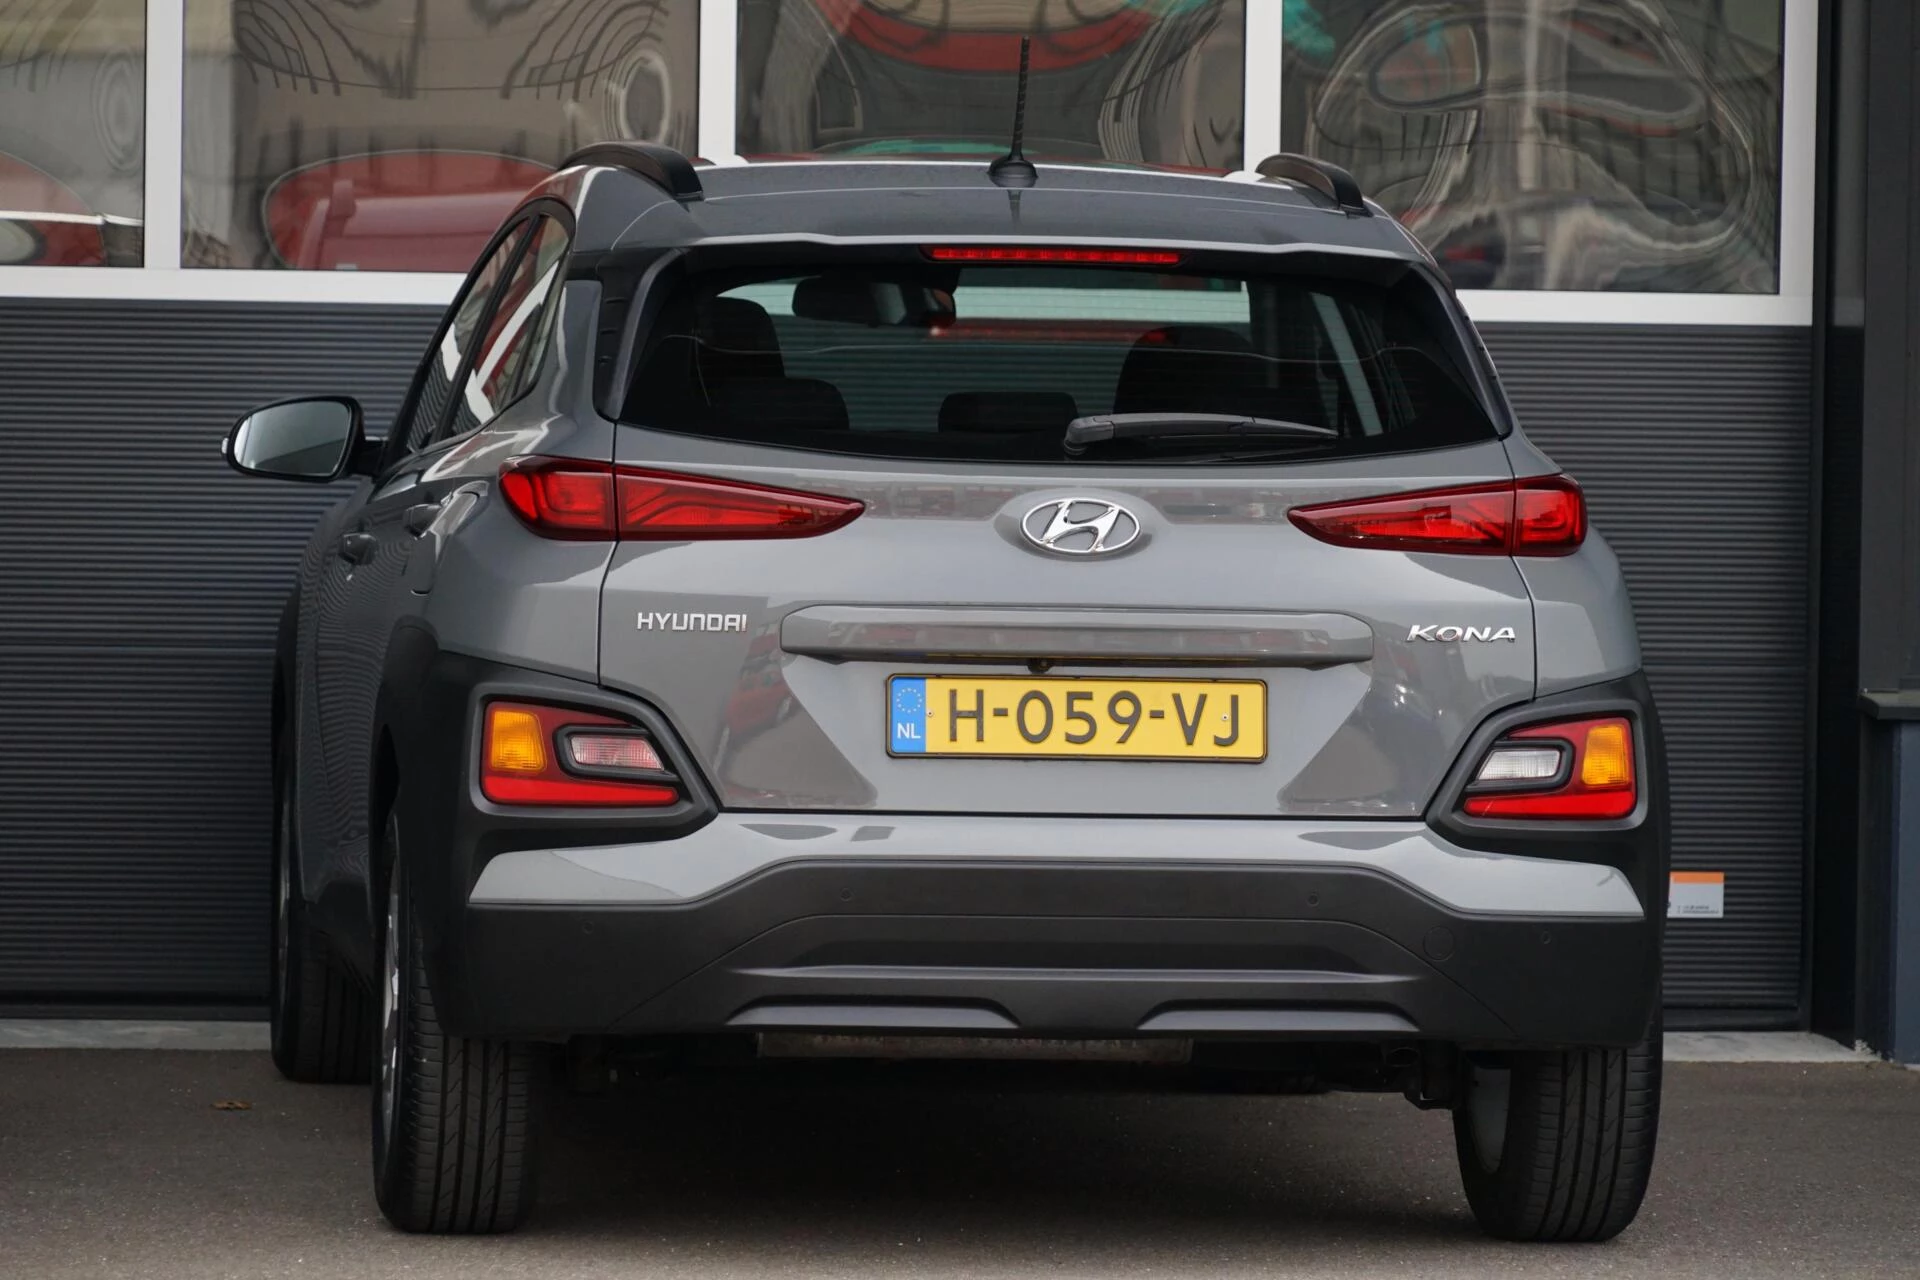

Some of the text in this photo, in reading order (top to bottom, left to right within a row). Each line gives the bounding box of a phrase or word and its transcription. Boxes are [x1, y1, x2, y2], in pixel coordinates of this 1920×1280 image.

[637, 612, 748, 632] HYUNDAI
[1406, 624, 1516, 642] KONA
[948, 688, 1240, 747] H-059-VJ
[896, 722, 921, 740] NL
